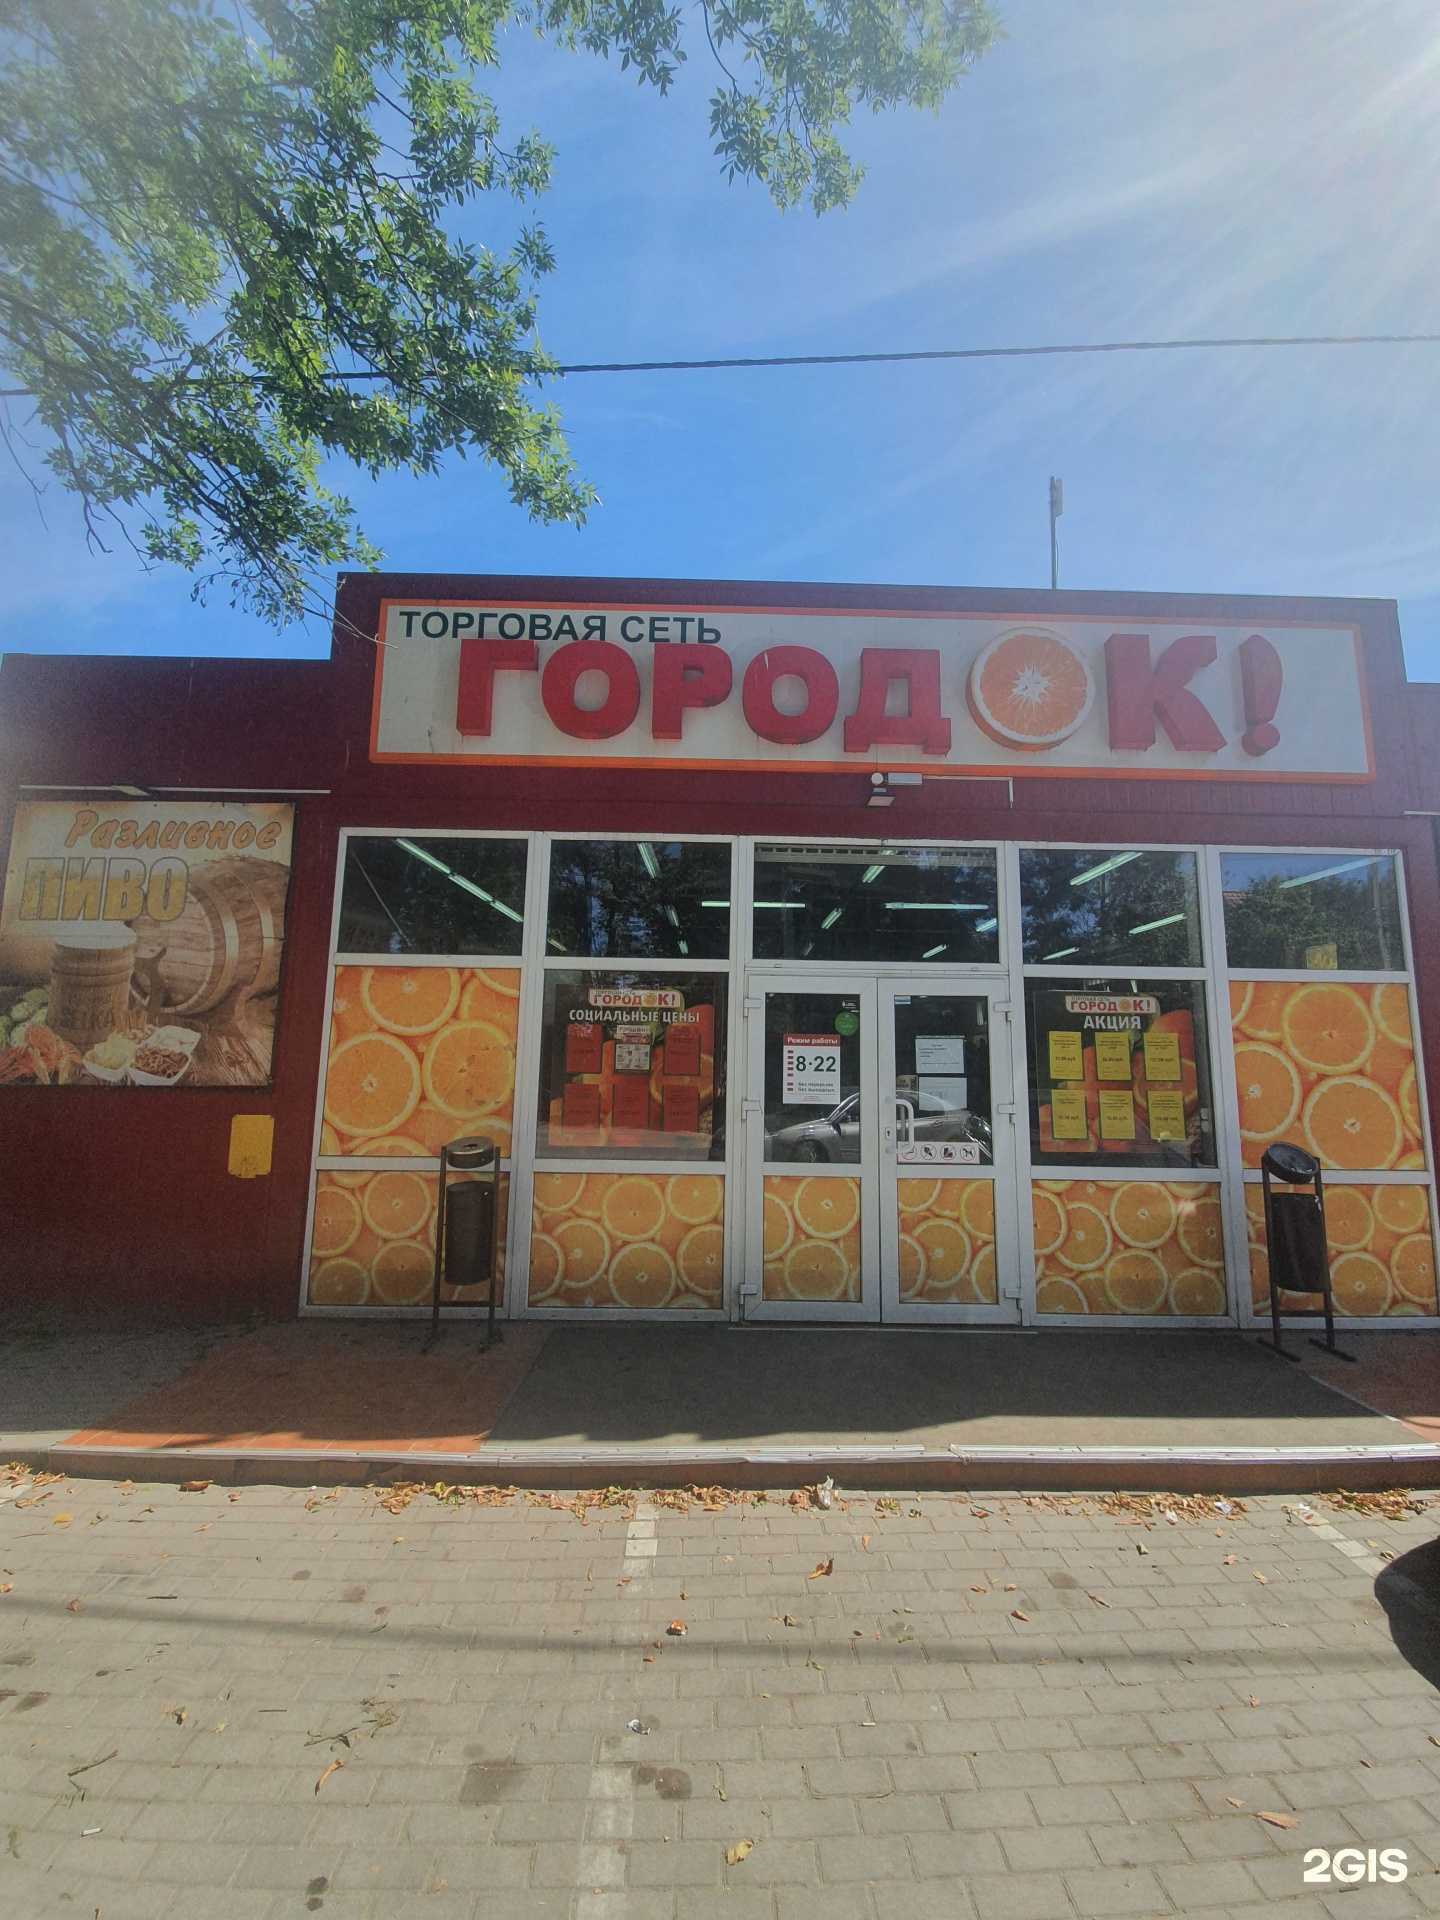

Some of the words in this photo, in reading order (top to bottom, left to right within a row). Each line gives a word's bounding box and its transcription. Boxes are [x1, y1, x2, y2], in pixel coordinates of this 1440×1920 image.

[399, 611, 607, 642] ТОРГОВАЯ
[620, 615, 722, 644] СЕТЬ
[65, 809, 283, 849] Разливное
[19, 857, 190, 921] ПИВО
[569, 1009, 659, 1022] СОЦИАЛЬНЫЕ
[662, 1011, 700, 1024] ЦЕНЫ
[1083, 1015, 1142, 1031] АКЦИЯ
